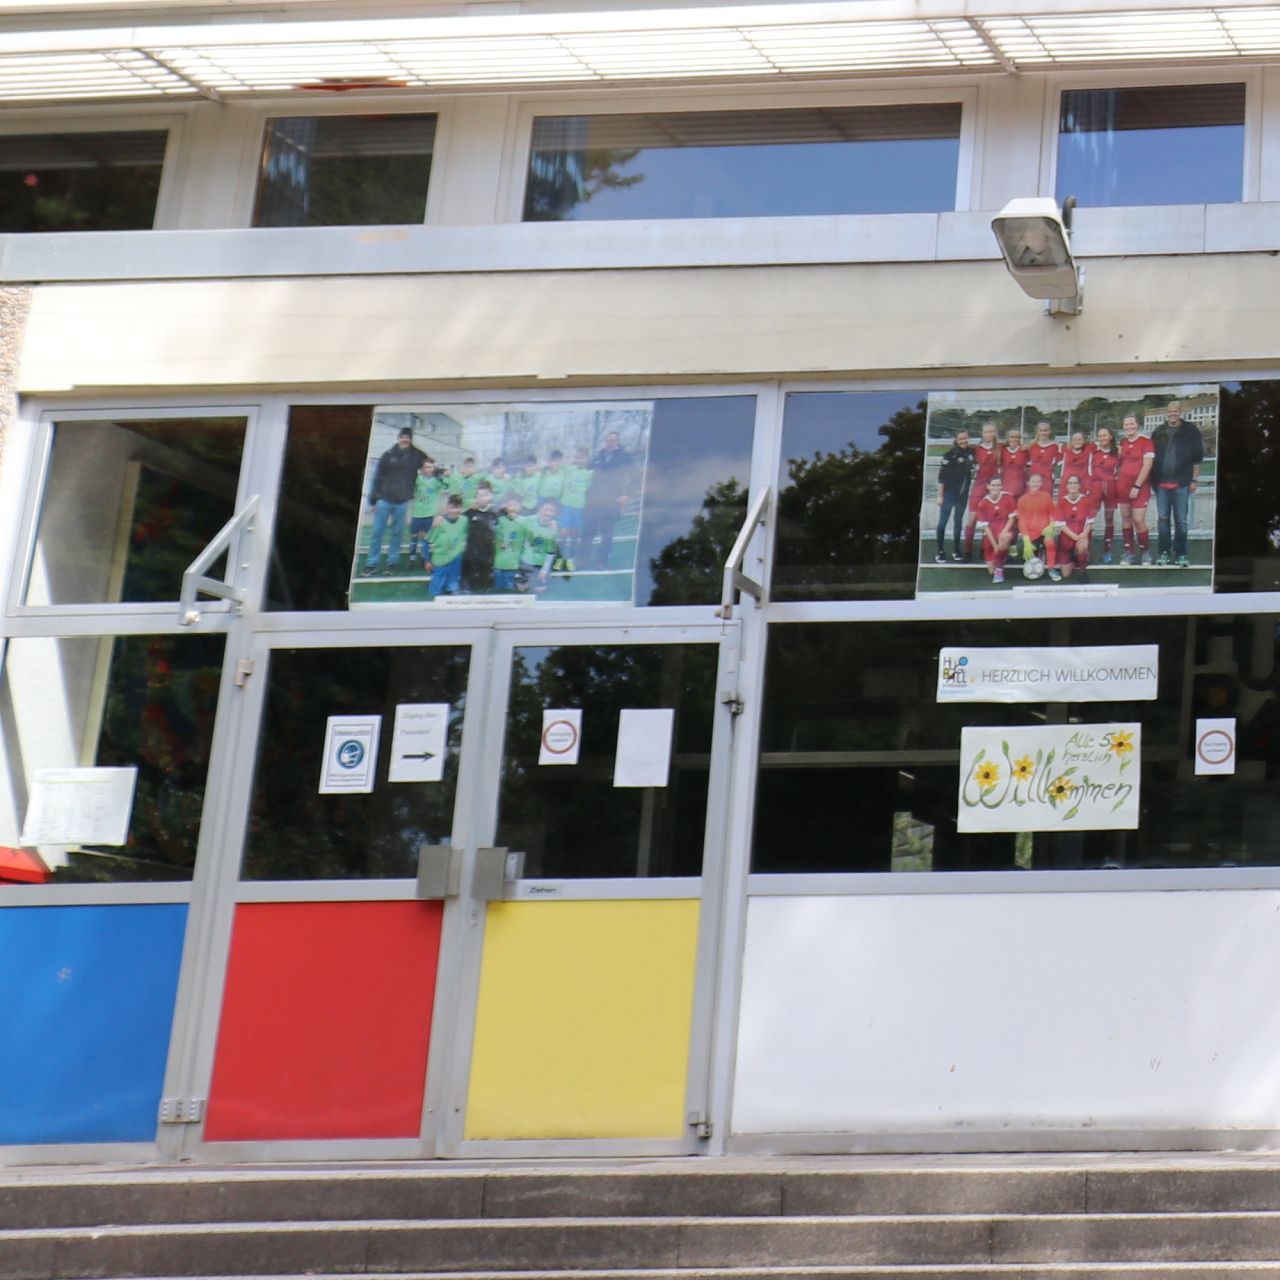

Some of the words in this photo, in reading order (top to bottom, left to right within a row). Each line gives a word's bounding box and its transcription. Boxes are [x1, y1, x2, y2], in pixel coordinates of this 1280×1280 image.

[982, 668, 1050, 683] HERZLICH
[1055, 666, 1157, 683] WILLKOMMEN
[1065, 732, 1095, 748] Alle
[1061, 749, 1113, 766] herzlich
